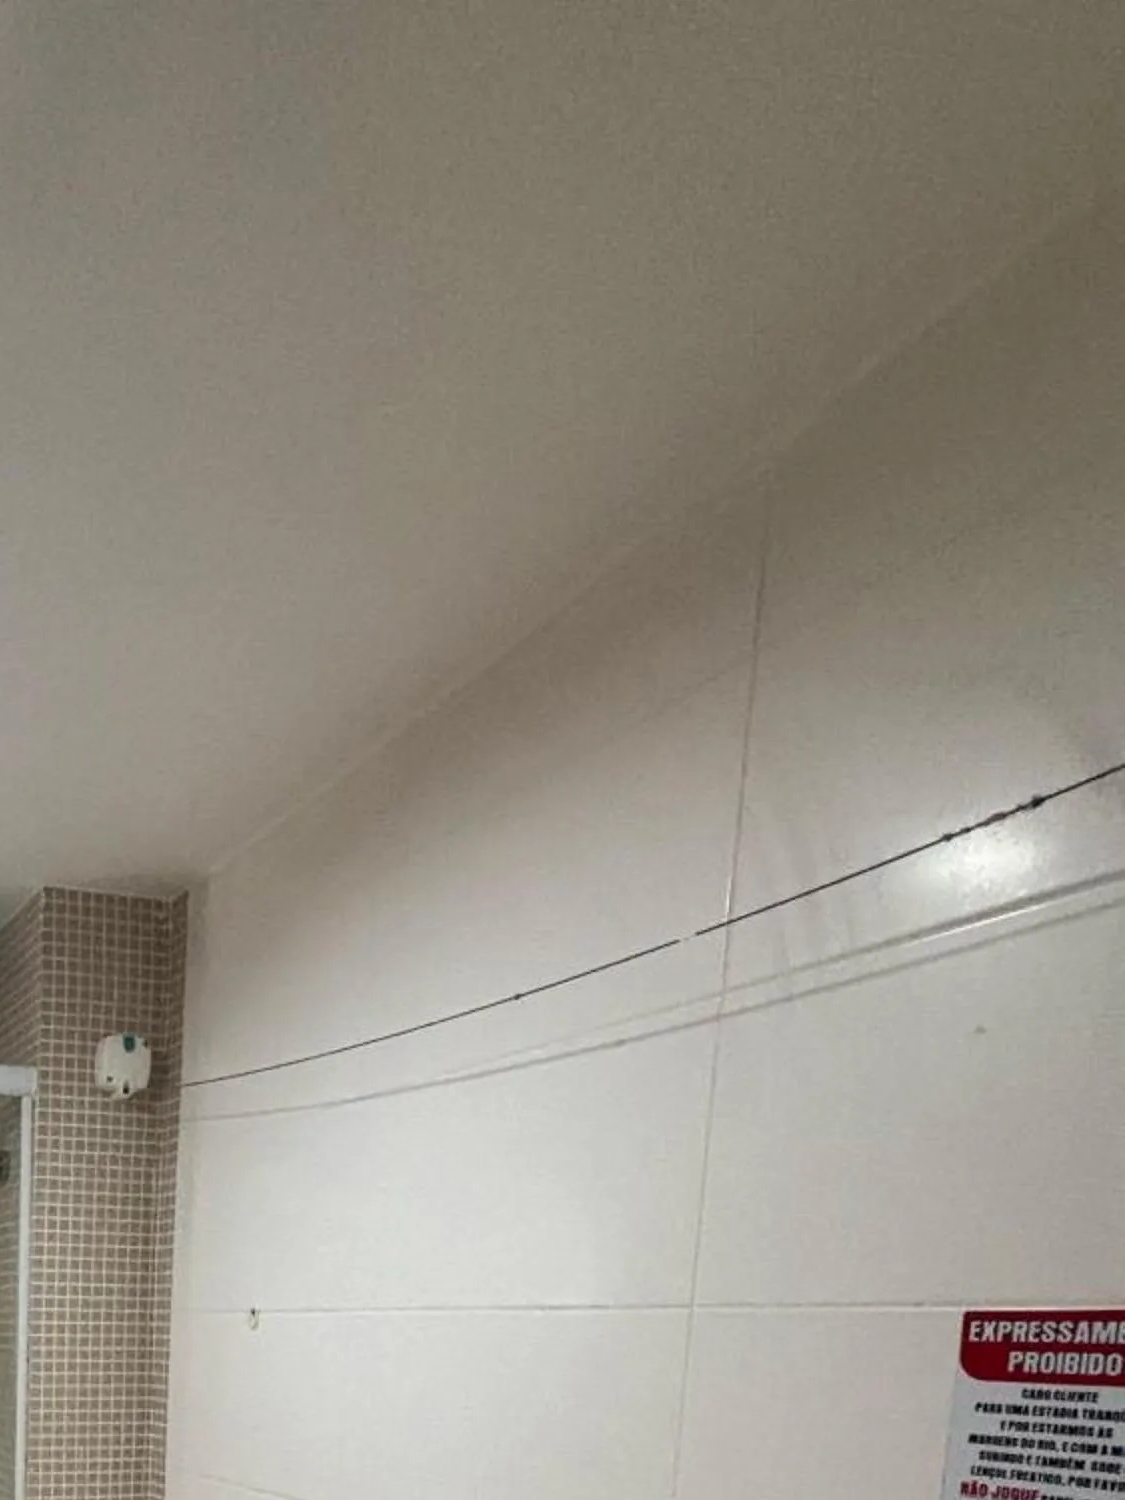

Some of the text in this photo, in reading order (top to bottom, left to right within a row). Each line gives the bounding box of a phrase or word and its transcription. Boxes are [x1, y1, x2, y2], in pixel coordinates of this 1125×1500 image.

[1007, 1351, 1123, 1376] PROIBIDO
[1053, 1390, 1099, 1403] CLIENTE
[960, 1479, 988, 1497] NÃO
